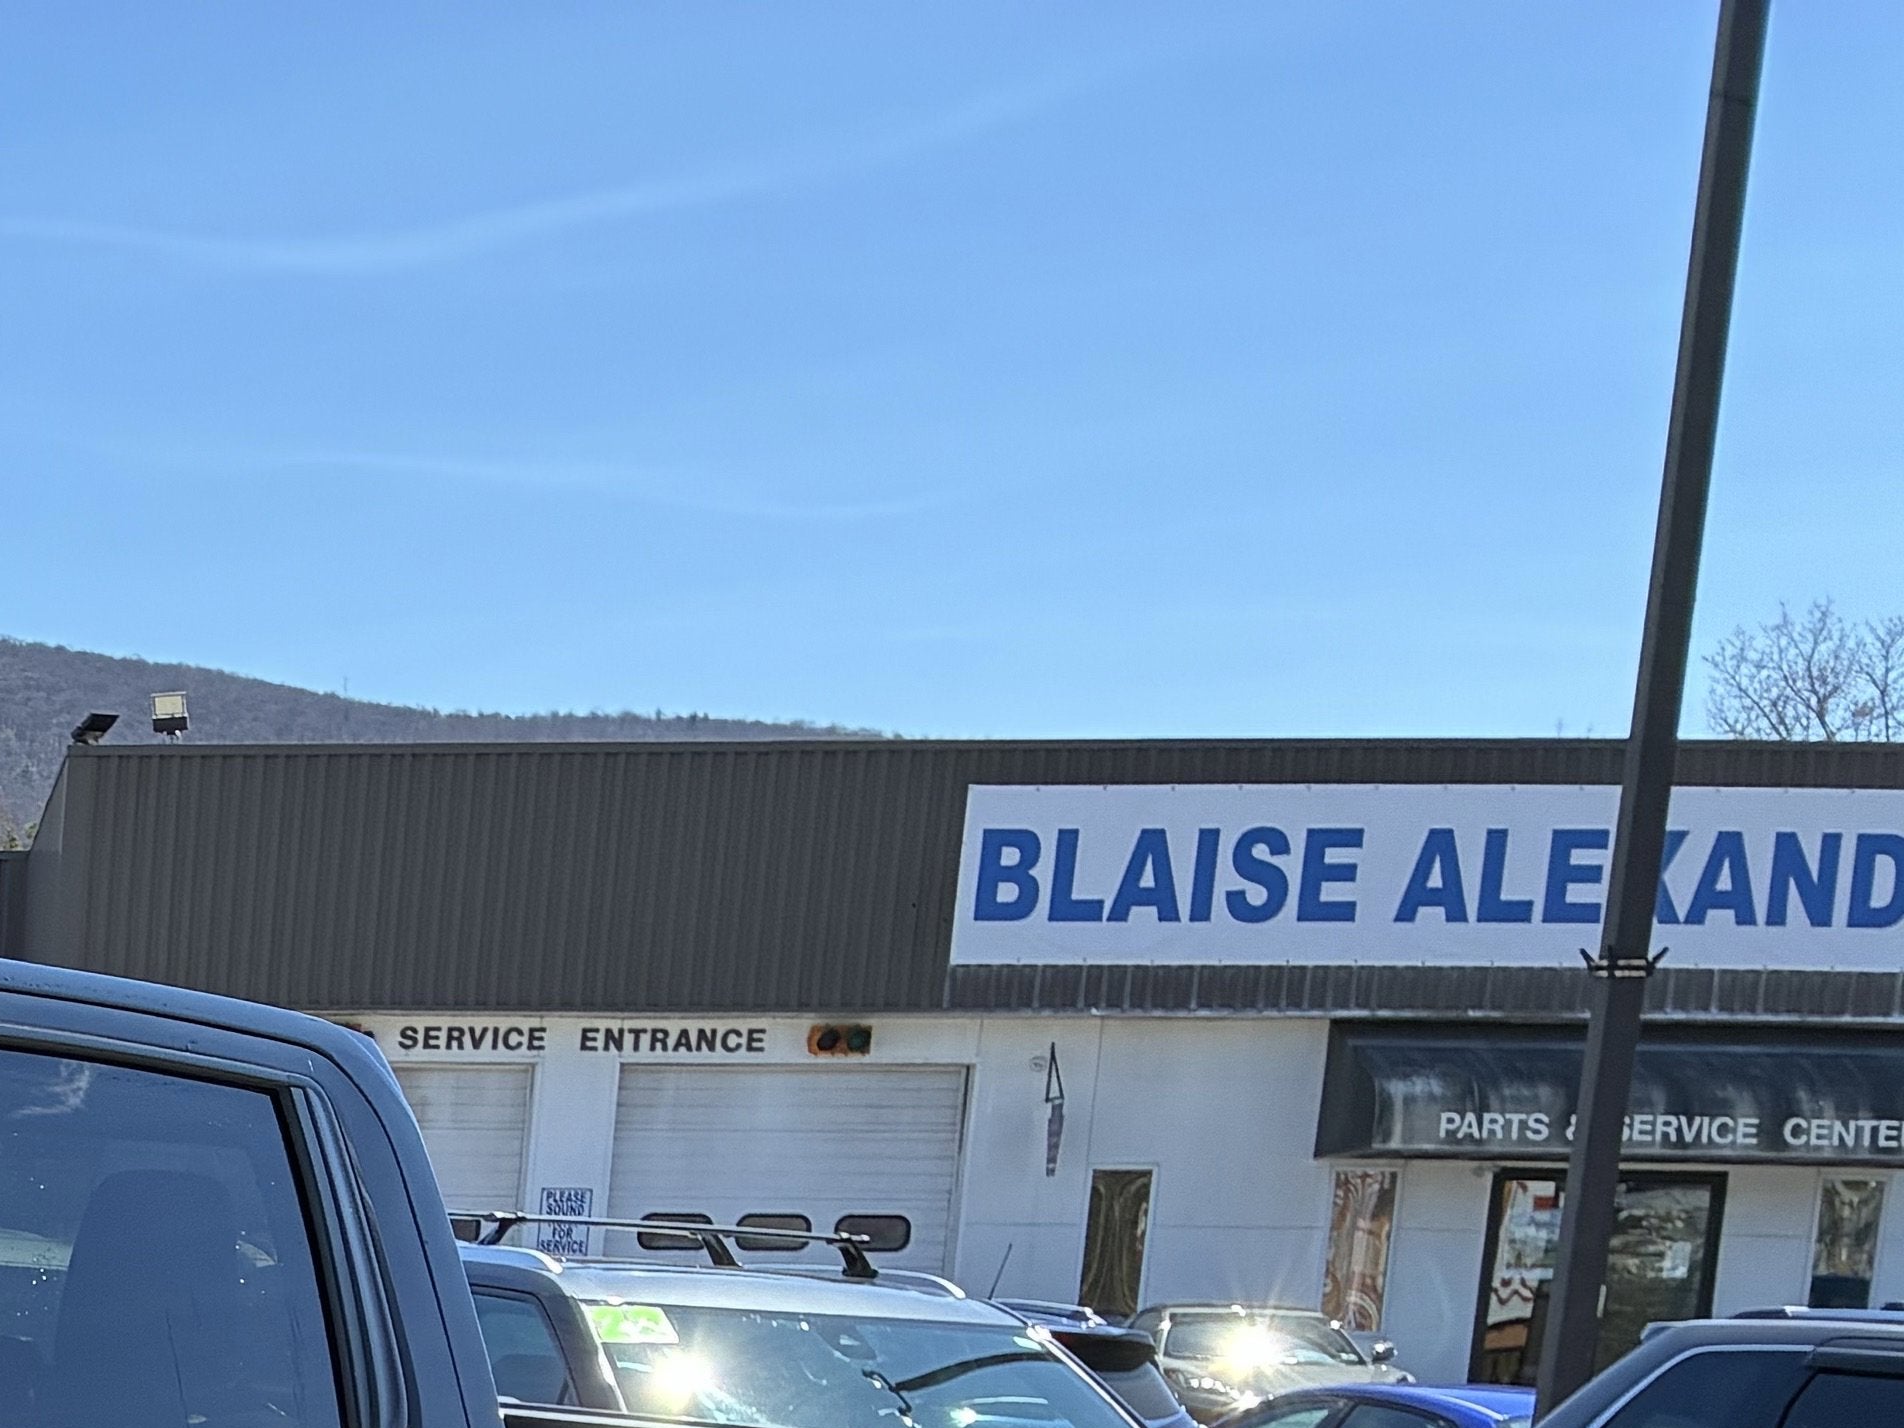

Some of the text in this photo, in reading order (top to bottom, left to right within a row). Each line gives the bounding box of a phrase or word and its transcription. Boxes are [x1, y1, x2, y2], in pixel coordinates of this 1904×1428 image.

[973, 825, 1366, 924] BLAISE
[397, 1026, 767, 1054] SERVICE ENTRANCE
[1439, 1111, 1550, 1142] PARTS
[1782, 1116, 1904, 1149] CENTE
[546, 1190, 587, 1204] PLEASE
[546, 1203, 585, 1216] SOUND
[540, 1239, 585, 1255] SERVICE
